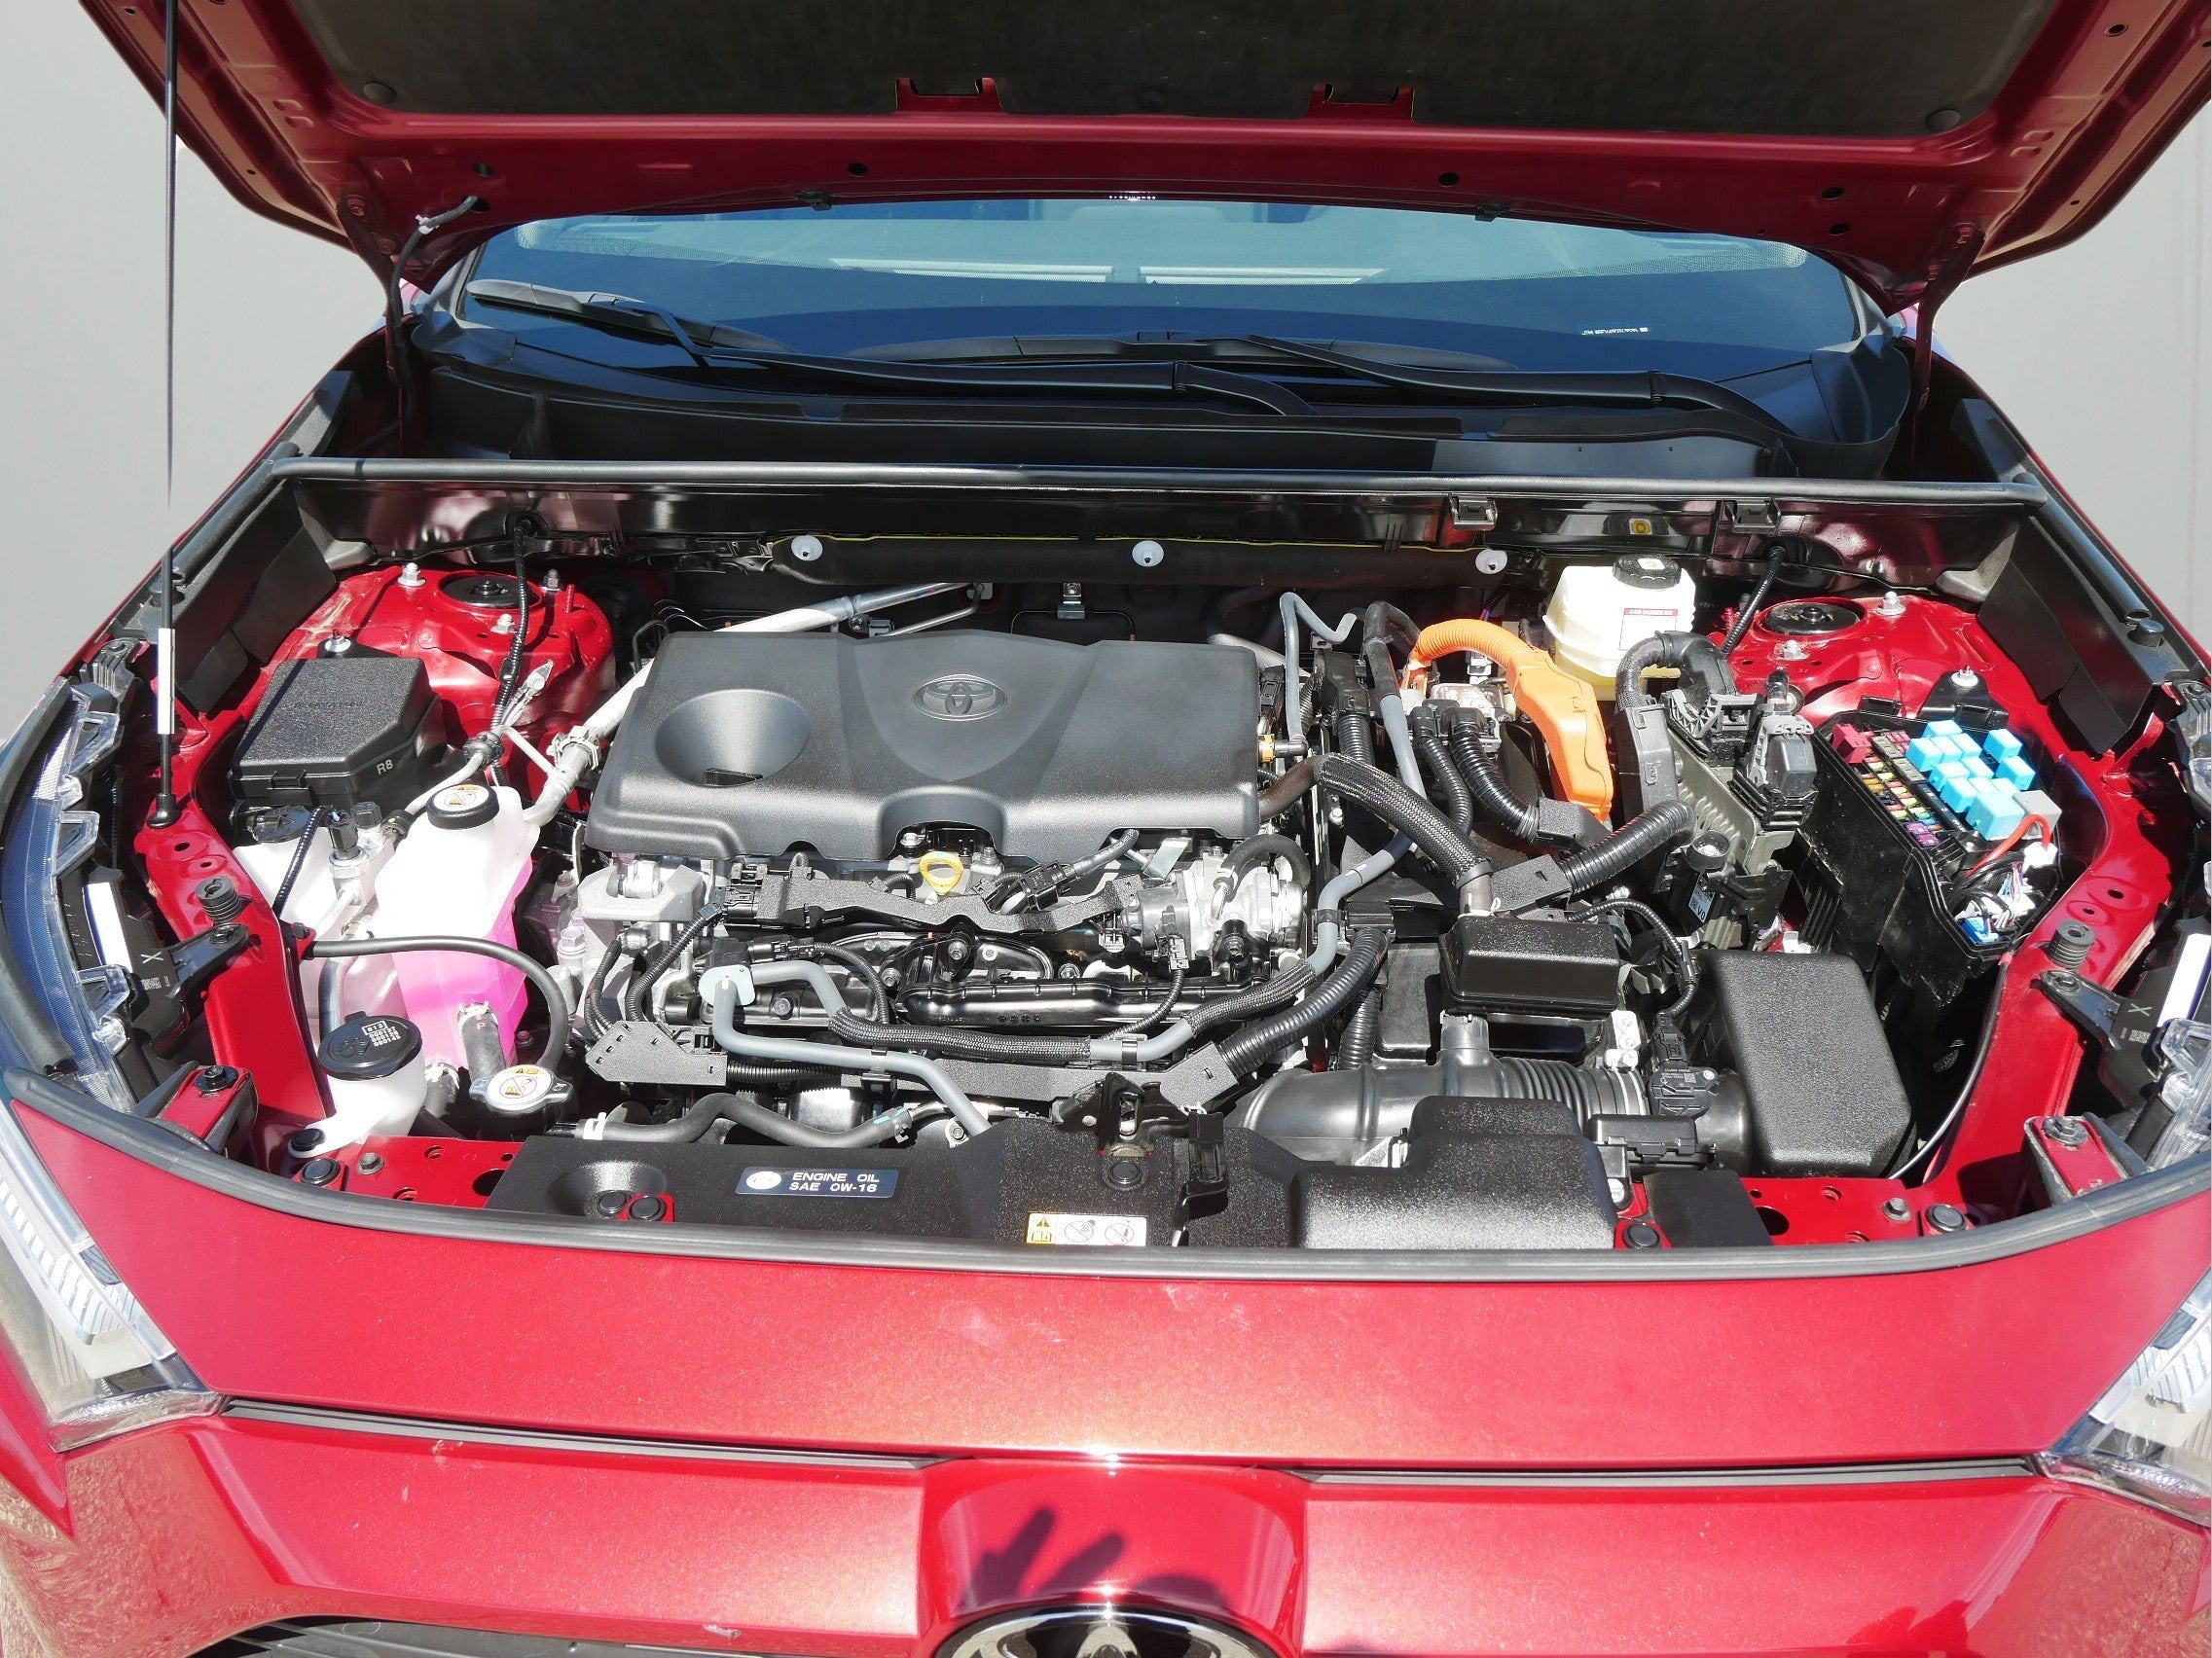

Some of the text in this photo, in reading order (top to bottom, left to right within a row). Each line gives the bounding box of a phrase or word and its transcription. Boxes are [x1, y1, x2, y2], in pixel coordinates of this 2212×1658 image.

[377, 759, 393, 775] R8
[792, 1171, 880, 1183] ENGINE OIL
[789, 1181, 821, 1192] SAE
